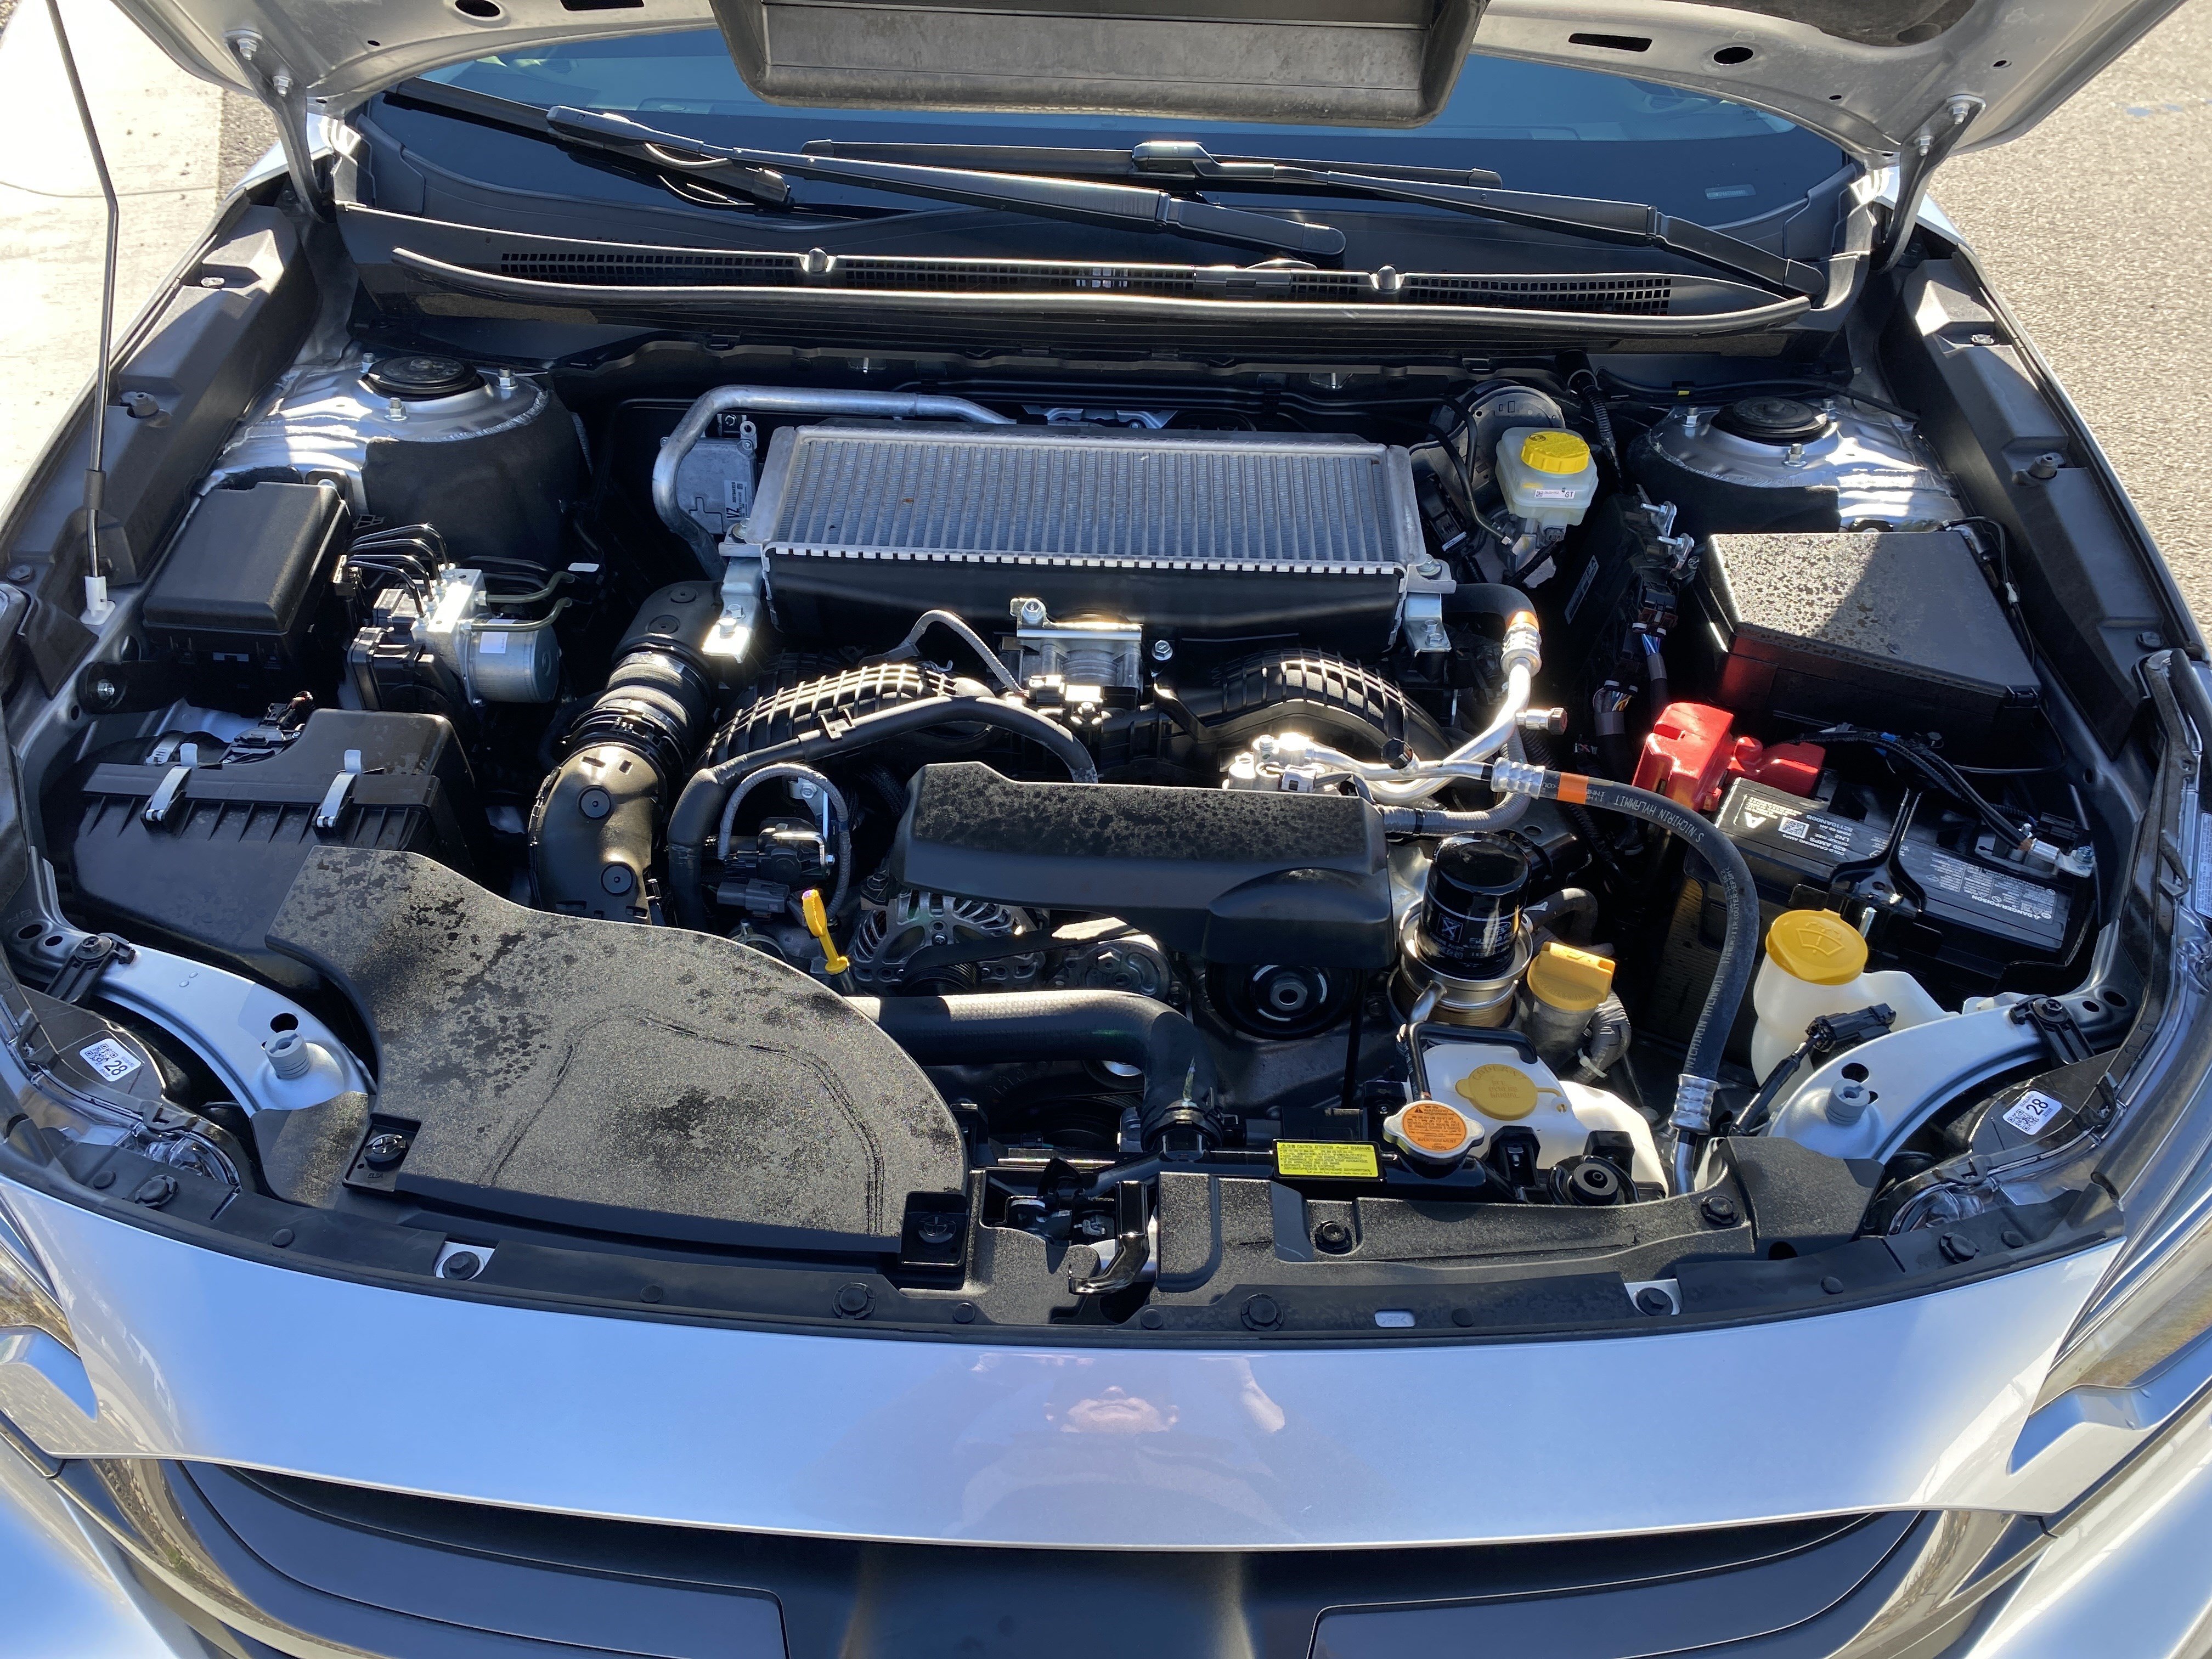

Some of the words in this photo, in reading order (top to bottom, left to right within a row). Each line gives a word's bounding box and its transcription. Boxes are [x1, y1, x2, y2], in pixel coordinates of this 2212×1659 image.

[726, 507, 740, 518] VZ
[1613, 795, 1657, 816] HYLAMMIT
[1745, 812, 1767, 828] A
[1809, 837, 1832, 847] AMPS
[1827, 838, 1850, 847] GROUP
[1834, 834, 1850, 842] LN2
[1799, 839, 1828, 851] CRANKING
[104, 1060, 128, 1075] 28
[2019, 1094, 2034, 1107] SUBARU
[2025, 1098, 2049, 1116] 28
